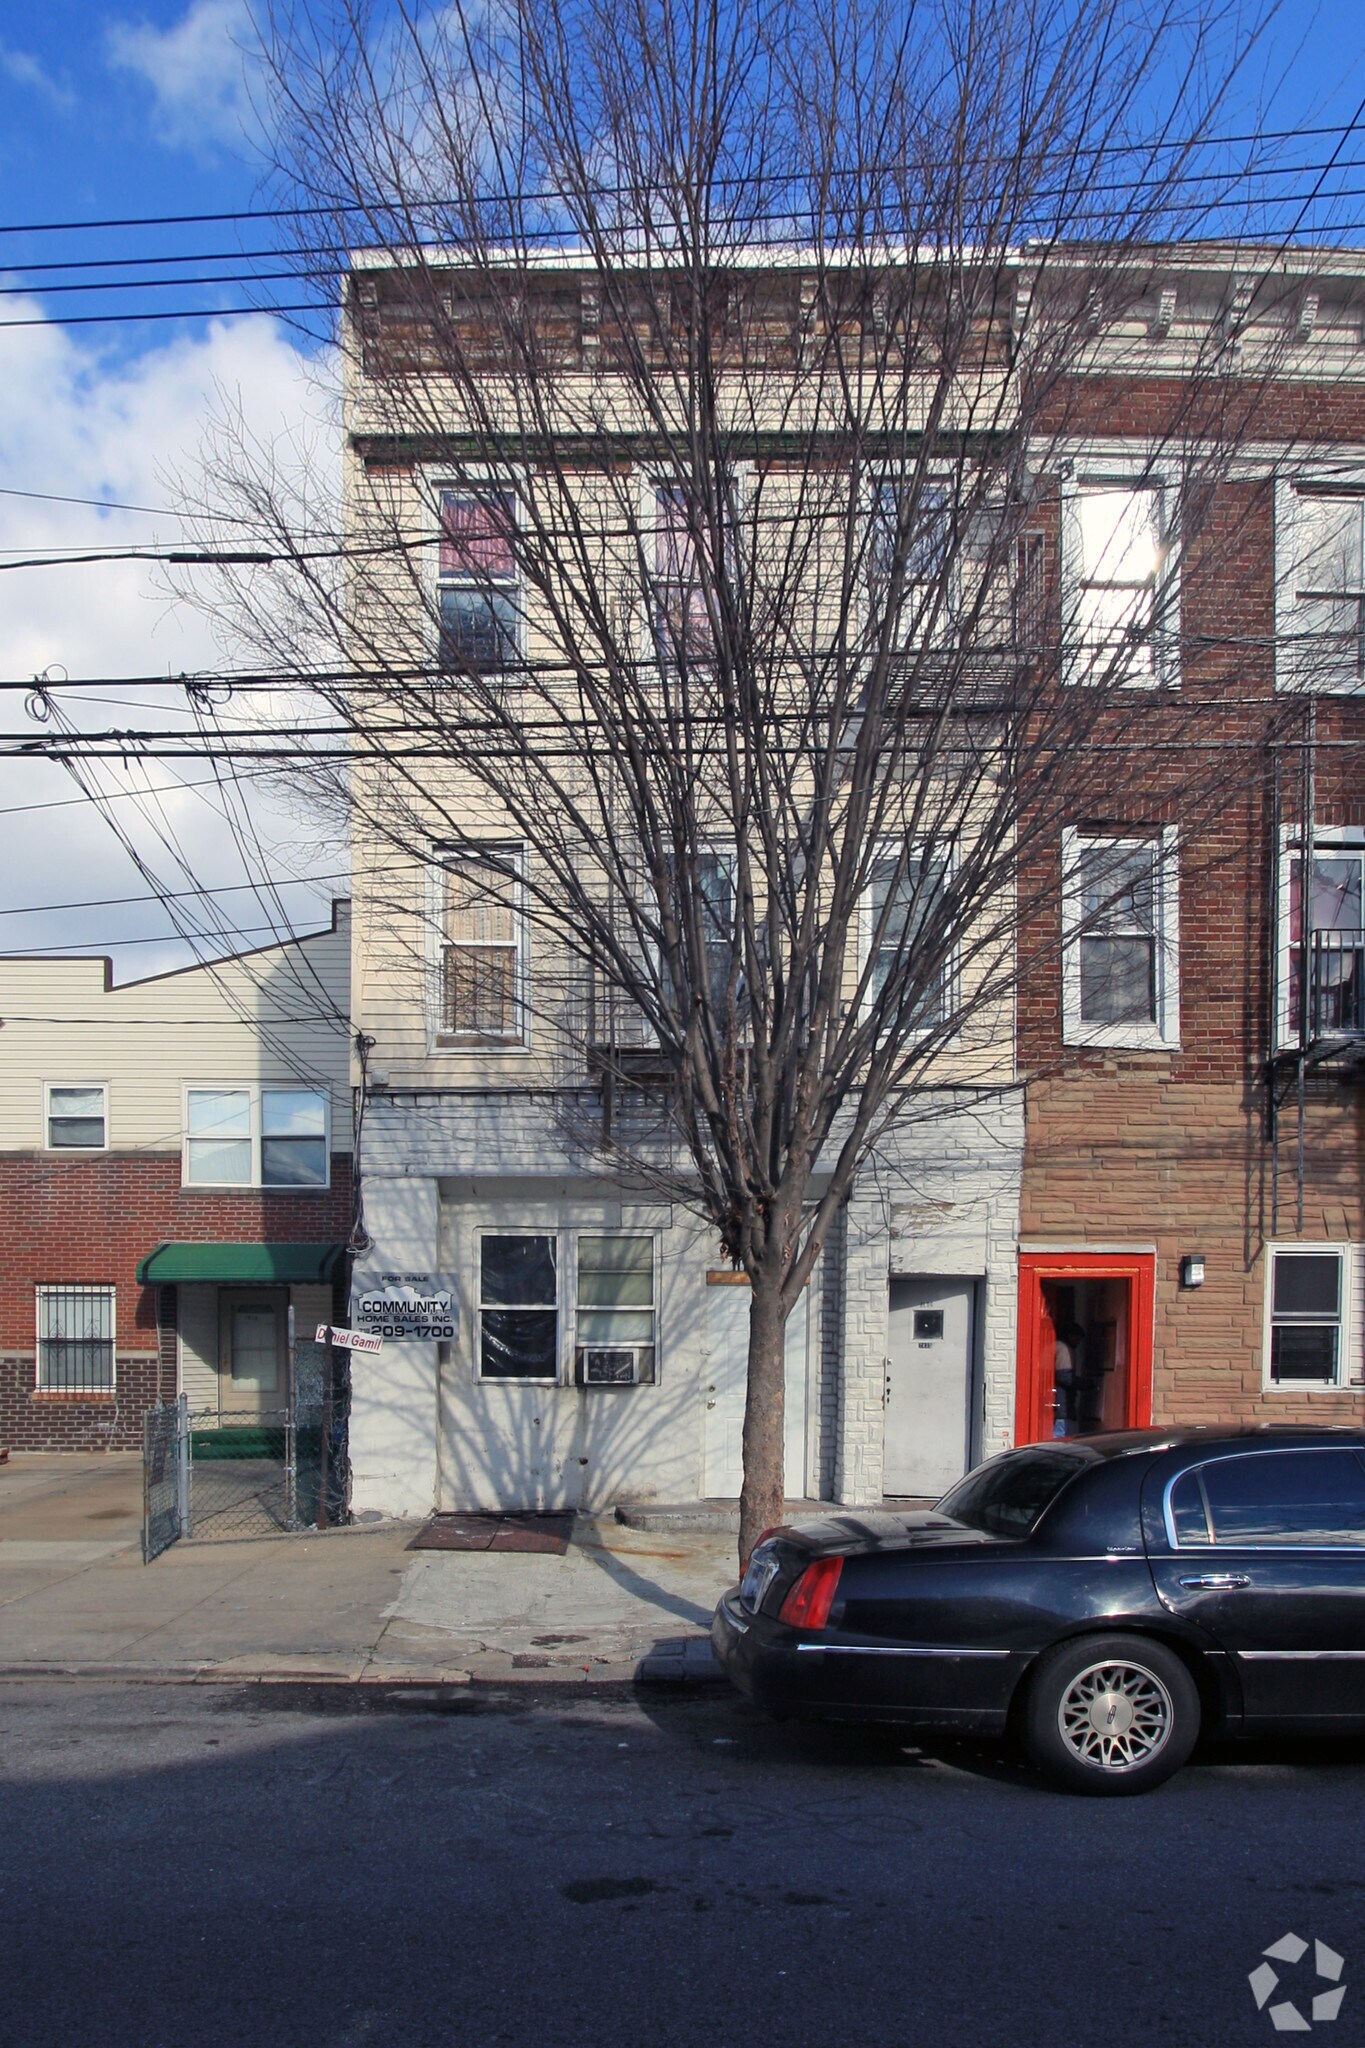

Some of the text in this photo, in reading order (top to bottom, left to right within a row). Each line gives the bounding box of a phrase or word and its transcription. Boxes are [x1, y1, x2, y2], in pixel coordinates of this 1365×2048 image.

[362, 1300, 449, 1314] COMMUNITY
[357, 1315, 453, 1323] HOME SALES INC.
[317, 1327, 350, 1344] Dniel
[371, 1325, 454, 1338] 209-1700
